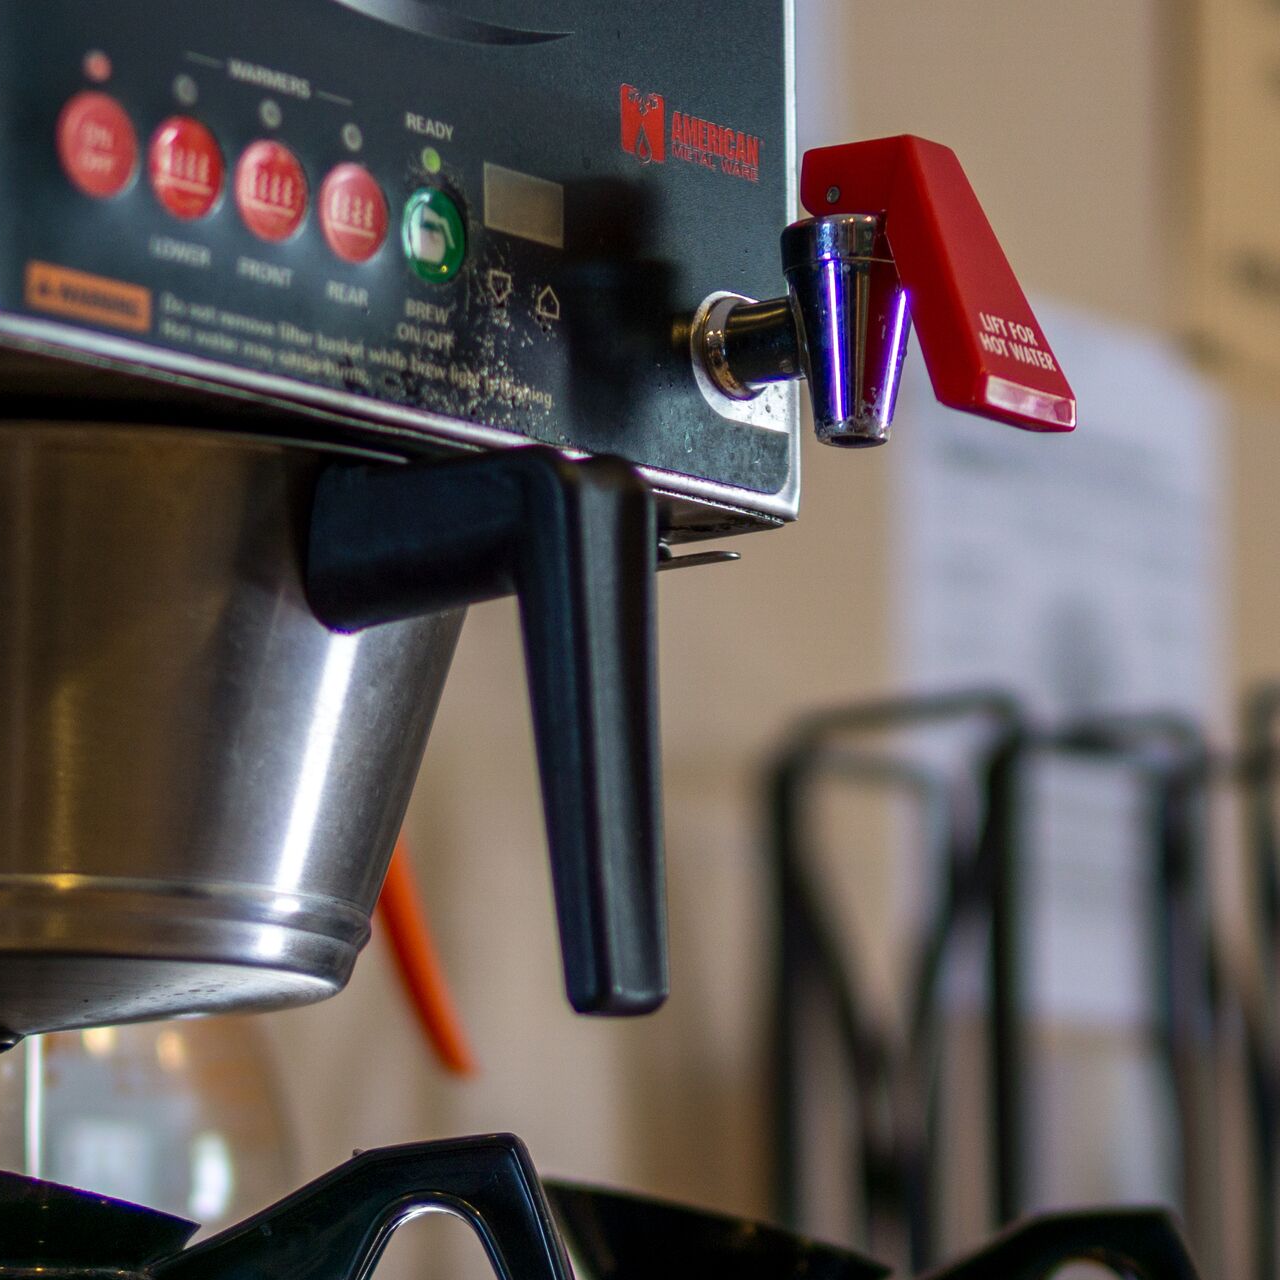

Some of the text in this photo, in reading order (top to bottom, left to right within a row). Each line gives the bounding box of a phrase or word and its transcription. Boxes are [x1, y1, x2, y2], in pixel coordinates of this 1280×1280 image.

[228, 57, 311, 99] WARMERS
[405, 111, 454, 141] READY
[671, 111, 759, 169] AMERICAN
[671, 142, 760, 184] METAL WARE
[150, 234, 211, 268] LOWER
[237, 255, 294, 288] FRONT
[326, 279, 369, 306] REAR
[405, 297, 450, 325] BREW
[979, 311, 1038, 347] LIFT FOR
[220, 311, 275, 337] remove
[370, 348, 408, 370] while
[411, 355, 446, 380] brew
[979, 331, 1057, 372] HOT WATER
